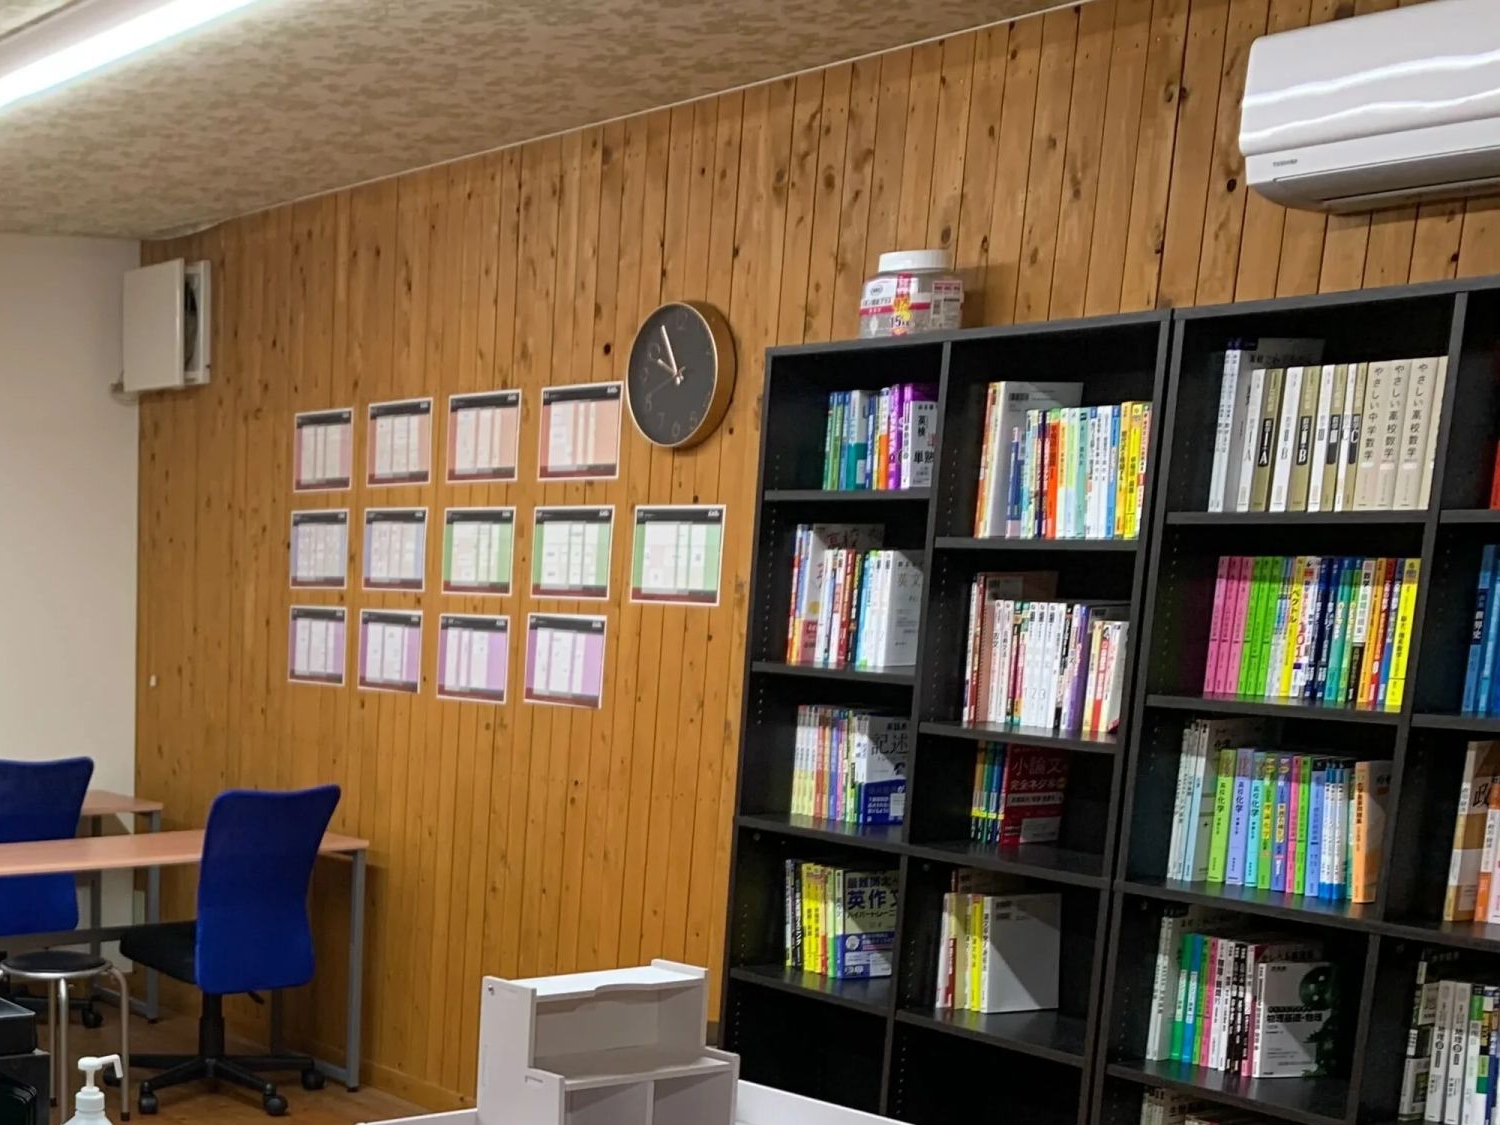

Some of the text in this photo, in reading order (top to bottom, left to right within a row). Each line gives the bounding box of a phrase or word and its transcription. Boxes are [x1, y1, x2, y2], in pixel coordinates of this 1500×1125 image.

[1288, 589, 1301, 624] ベクトル
[870, 733, 909, 755] 記述
